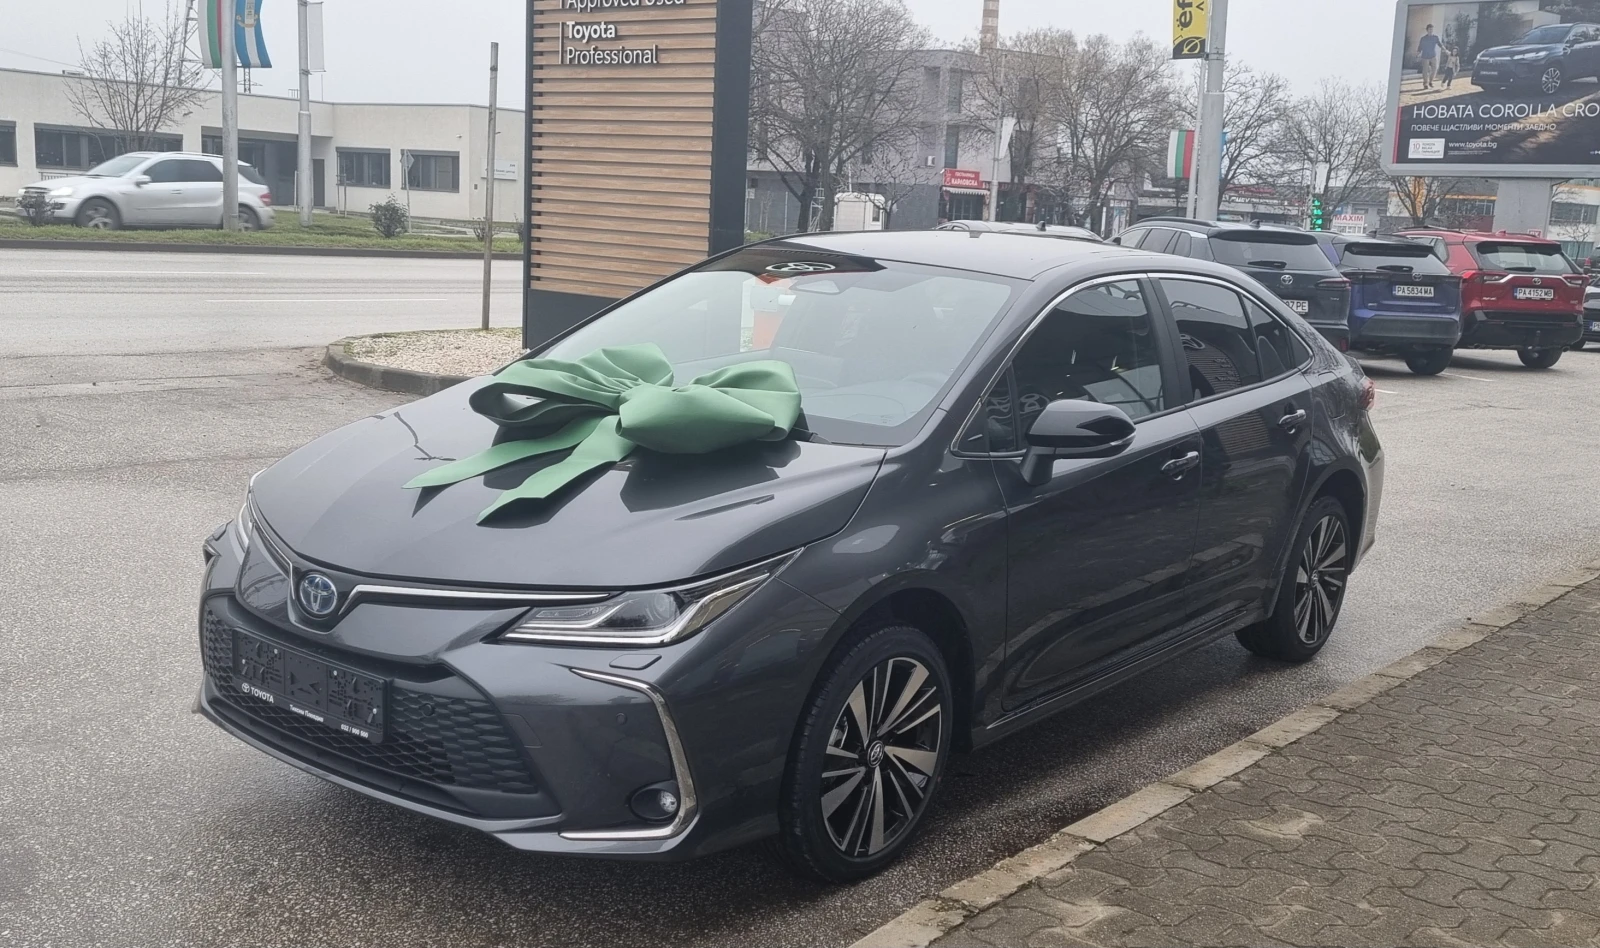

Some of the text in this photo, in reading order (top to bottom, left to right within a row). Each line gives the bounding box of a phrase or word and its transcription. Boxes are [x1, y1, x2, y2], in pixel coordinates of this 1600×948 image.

[566, 21, 616, 43] Toyota
[566, 44, 657, 64] Professional
[1413, 102, 1600, 119] НОВАТА COROLLA CRO
[1411, 123, 1557, 132] ПОВЕЧЕ ЩАСТЛИВИ МОМЕНТИ ЗАЕДНО
[1448, 141, 1497, 149] www.toyota.bg
[1296, 301, 1307, 311] PE
[250, 686, 274, 704] TOYOTA
